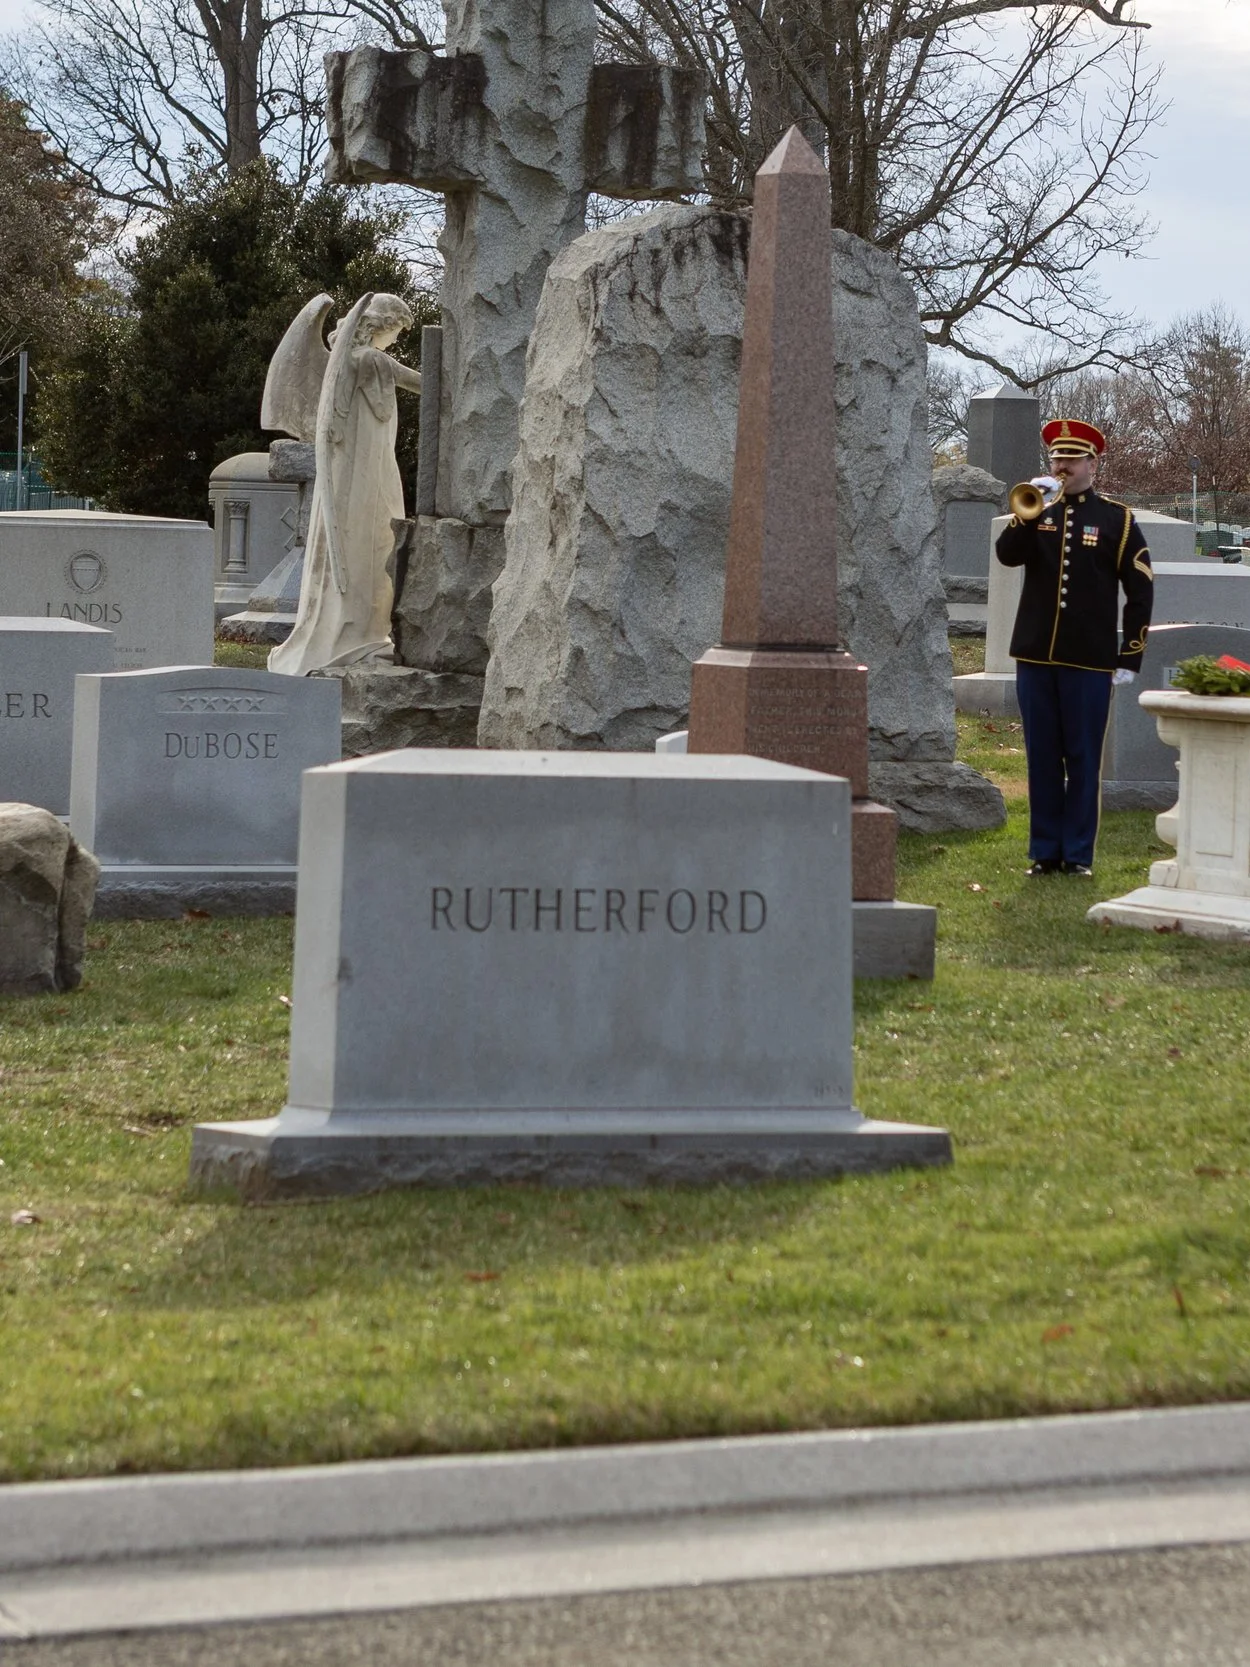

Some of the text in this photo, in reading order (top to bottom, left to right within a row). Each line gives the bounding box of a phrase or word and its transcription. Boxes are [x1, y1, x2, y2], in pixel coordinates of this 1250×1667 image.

[0, 692, 52, 719] ER
[760, 688, 804, 697] MEMORY
[807, 688, 818, 697] OF
[795, 725, 841, 735] ERECTED
[163, 732, 280, 759] DuBOSE
[430, 886, 768, 934] RUTHERFORD
